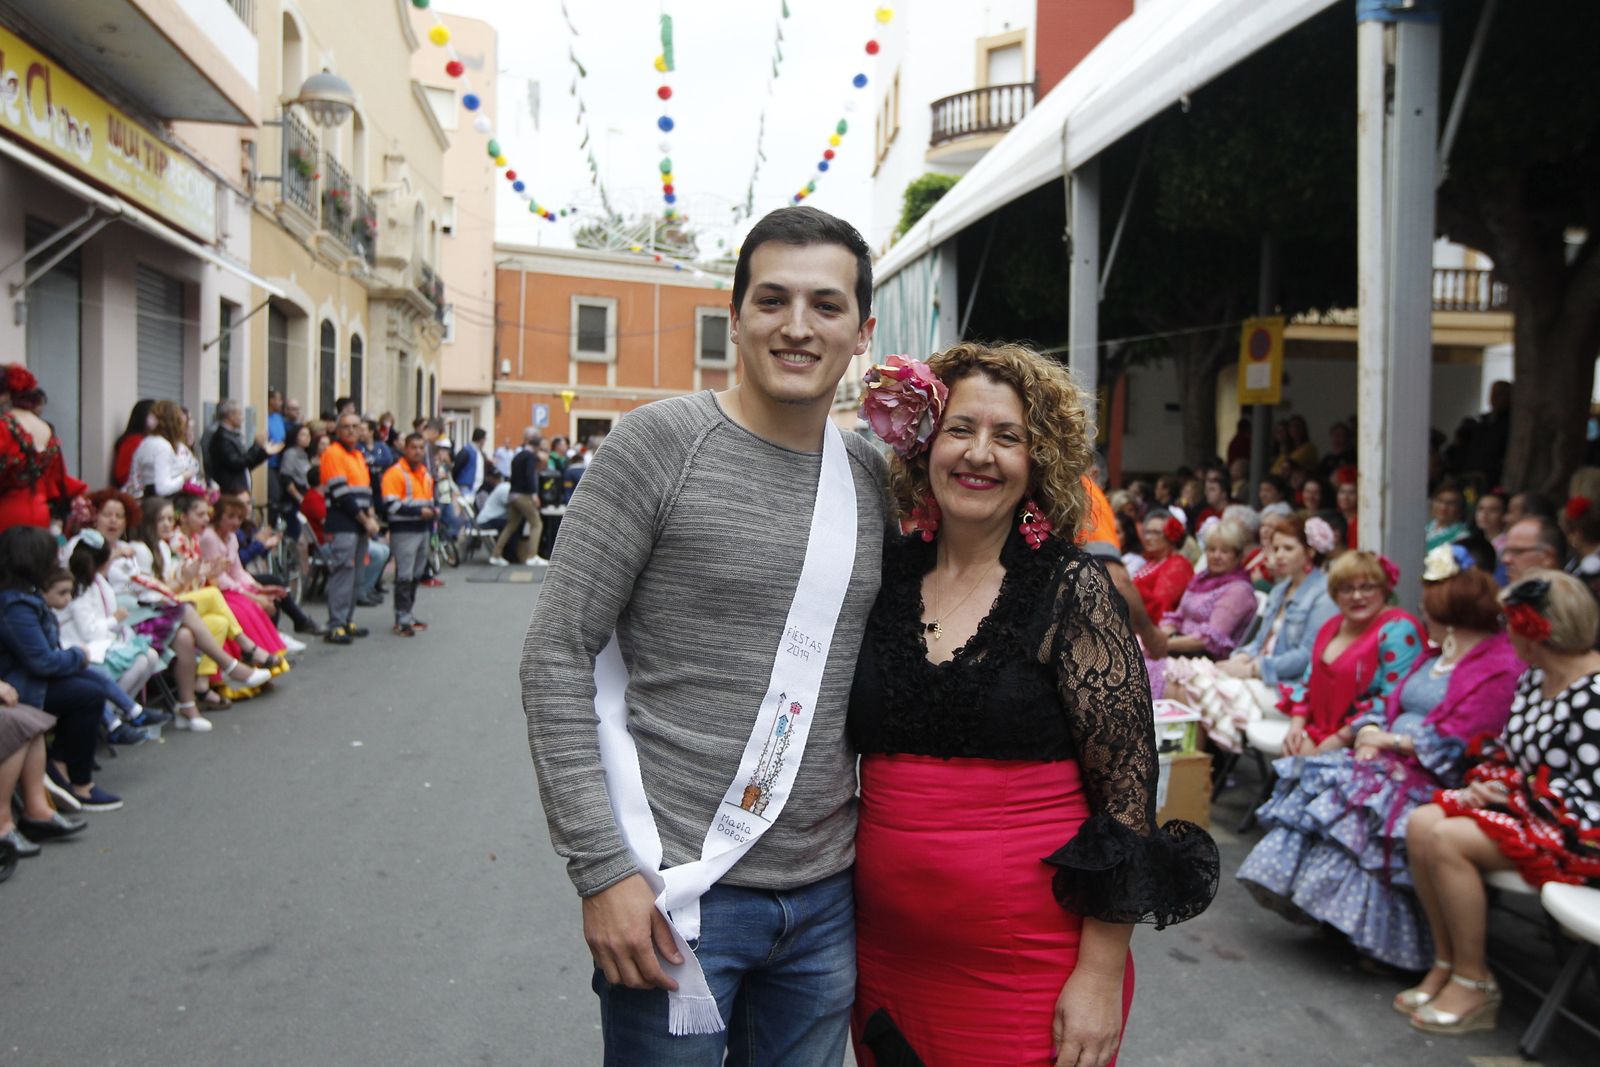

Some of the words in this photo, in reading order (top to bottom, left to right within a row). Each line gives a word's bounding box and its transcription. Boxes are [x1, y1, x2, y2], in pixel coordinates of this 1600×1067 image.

[536, 406, 546, 425] P
[787, 626, 822, 653] FIESTAS
[786, 642, 810, 661] 2019
